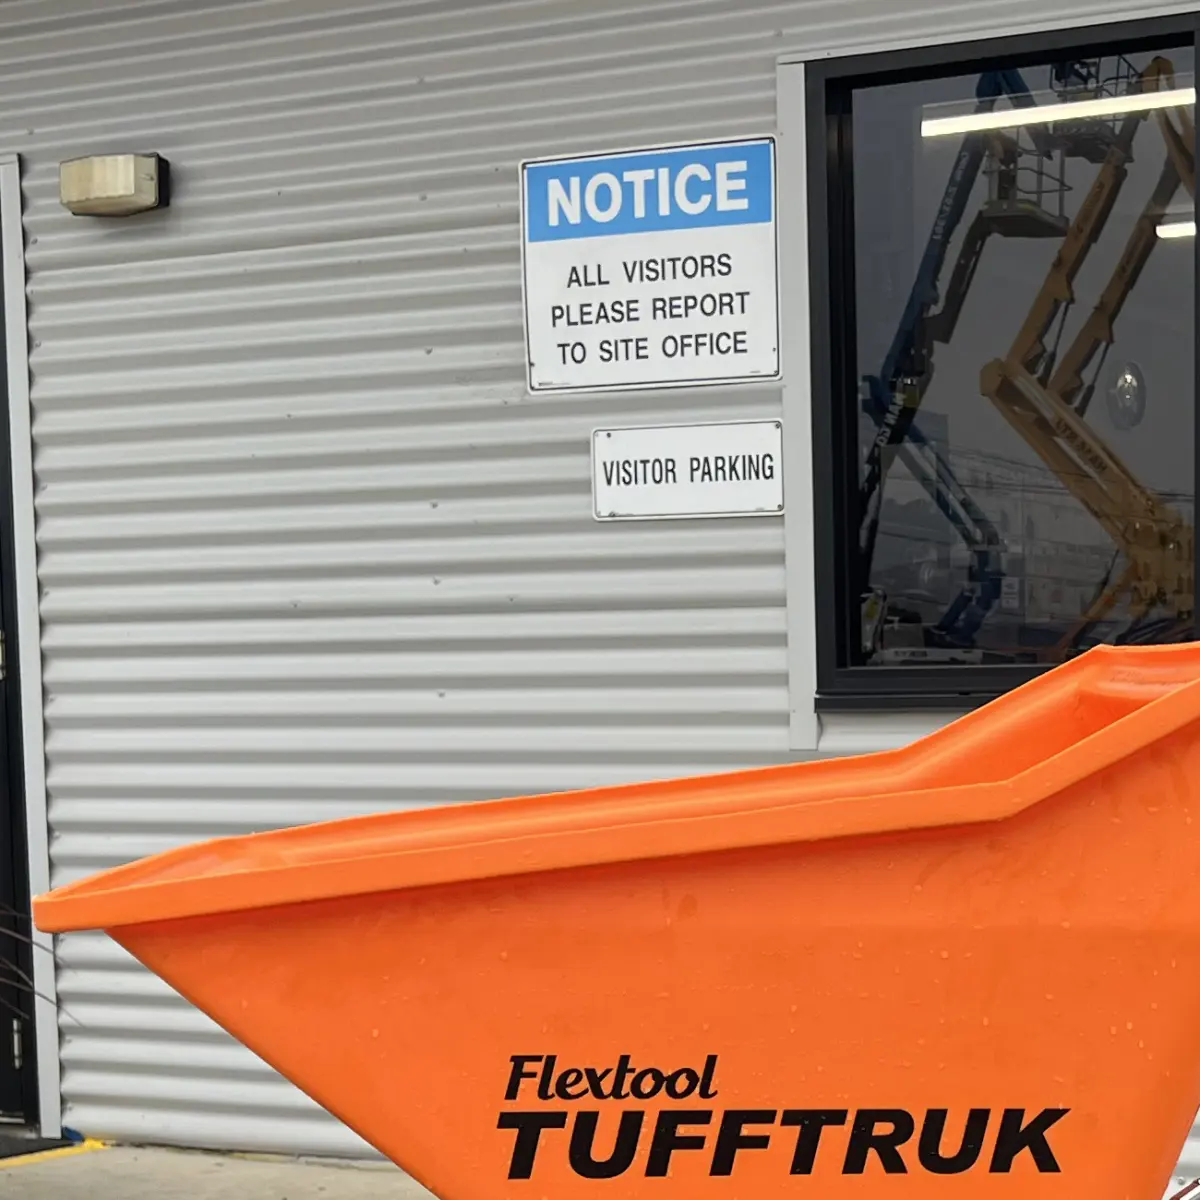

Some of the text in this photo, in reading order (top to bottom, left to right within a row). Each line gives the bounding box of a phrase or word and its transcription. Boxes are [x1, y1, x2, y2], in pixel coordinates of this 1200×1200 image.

[547, 160, 749, 227] NOTICE
[566, 253, 733, 289] ALL VISITORS
[551, 291, 751, 328] PLEASE REPORT
[557, 331, 748, 366] TO SITE OFFICE
[603, 453, 775, 487] VISITOR PARKING
[504, 1054, 718, 1101] Flextool
[496, 1107, 1071, 1180] TUFFTRUK
